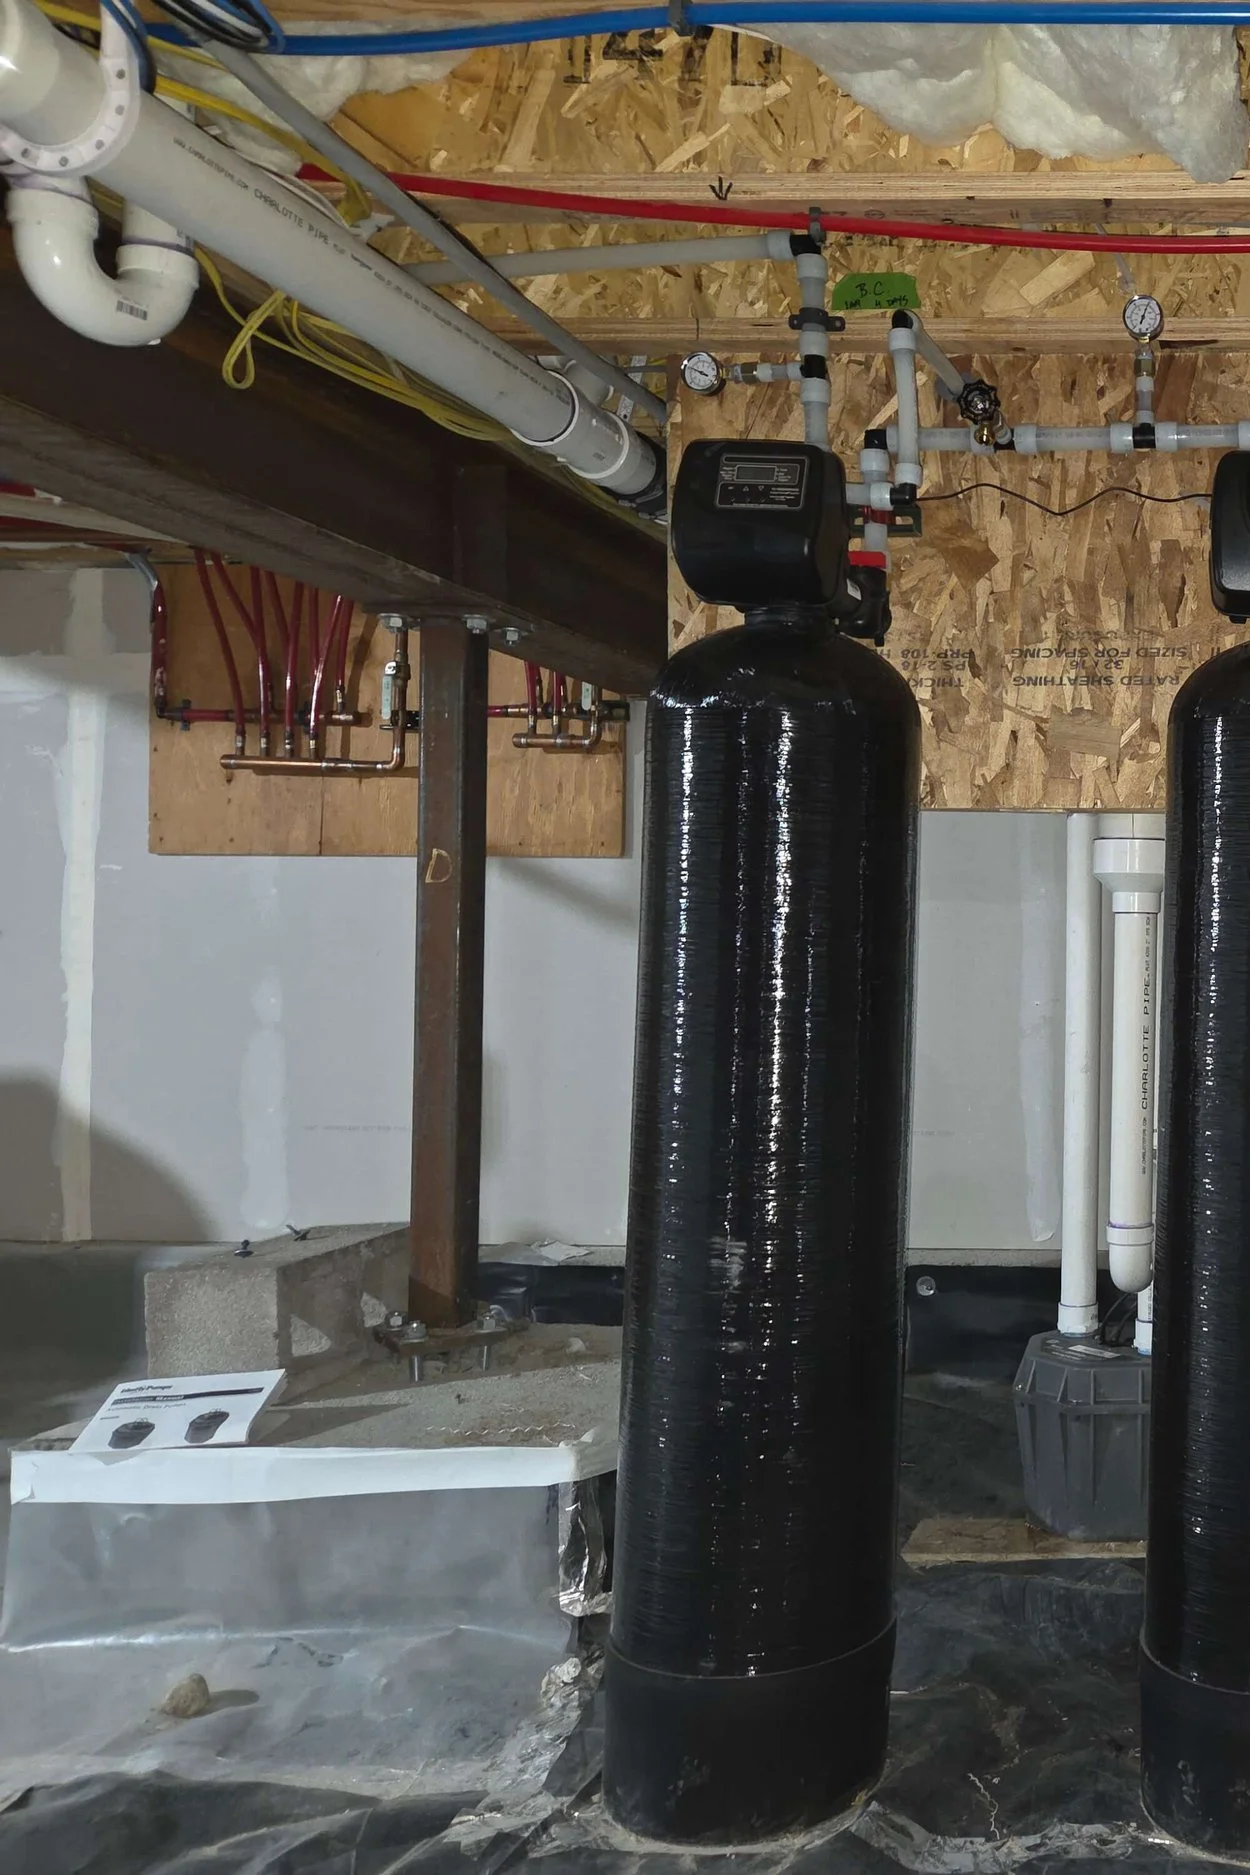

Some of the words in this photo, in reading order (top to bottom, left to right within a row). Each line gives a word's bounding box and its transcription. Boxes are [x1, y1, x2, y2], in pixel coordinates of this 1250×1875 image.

[253, 187, 305, 229] CHARLOTTE
[307, 222, 330, 246] PIPE
[1010, 647, 1089, 659] SPACING
[1094, 647, 1131, 658] FOR
[1136, 646, 1188, 658] SIZED
[1070, 659, 1087, 670] 16
[1104, 659, 1124, 670] 32
[907, 677, 964, 689] THICK
[1013, 676, 1115, 688] SHEATHING
[1120, 676, 1180, 687] RATED
[1143, 977, 1151, 1015] PIPE
[1141, 1025, 1150, 1110] CHARLOTTE
